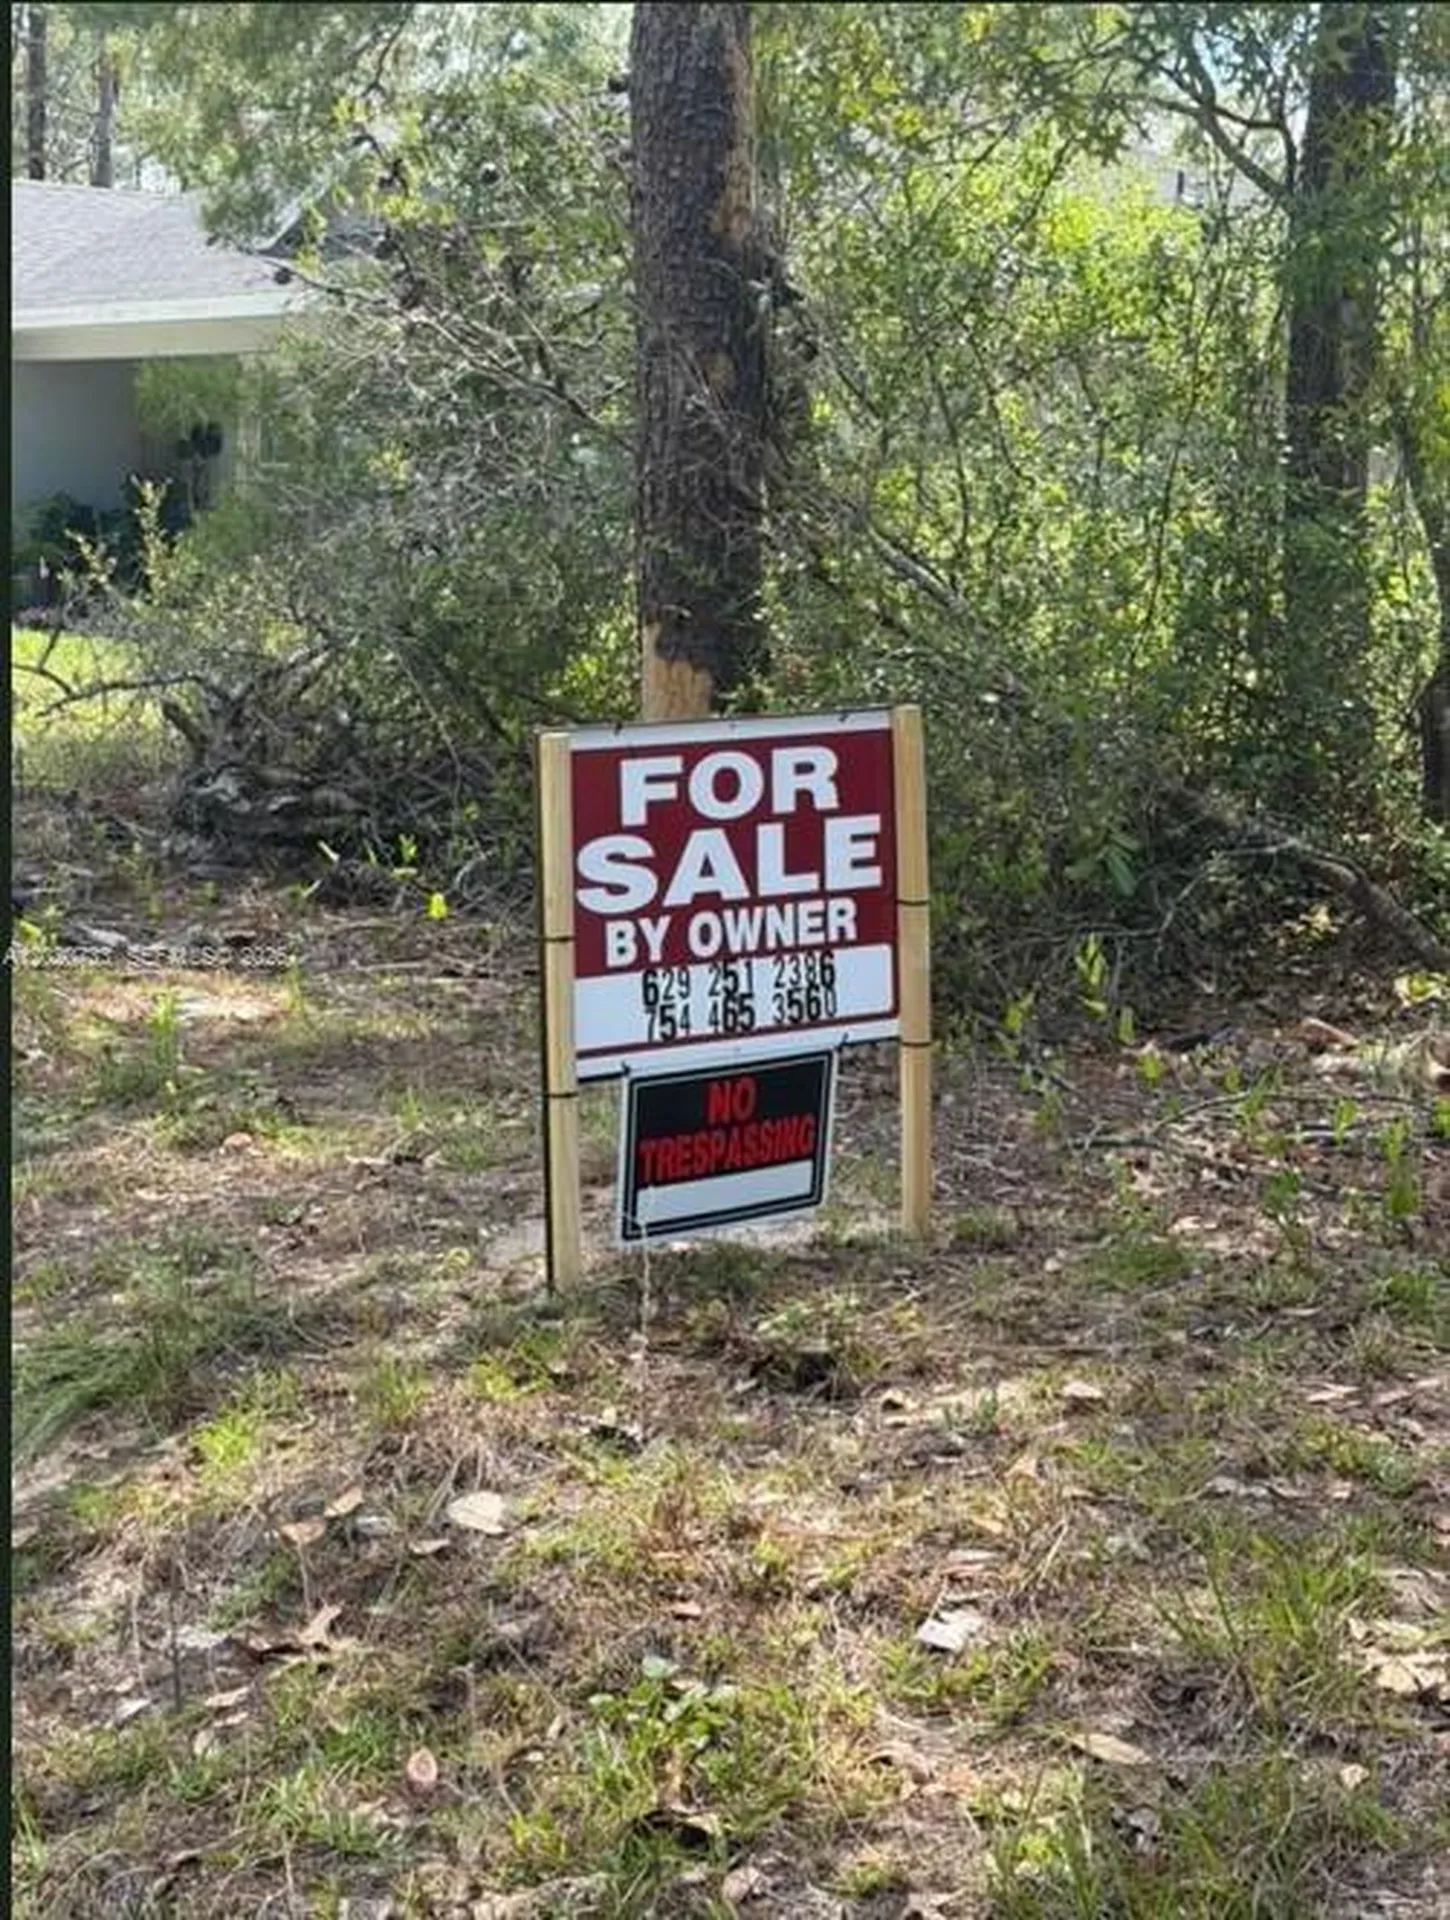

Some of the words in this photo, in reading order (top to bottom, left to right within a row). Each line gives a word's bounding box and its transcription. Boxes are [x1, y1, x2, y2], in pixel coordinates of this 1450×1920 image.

[620, 745, 840, 827] FOR
[576, 815, 882, 914] SALE
[606, 914, 671, 968] BY
[688, 899, 857, 958] OWNER
[642, 967, 691, 1006] 629
[708, 958, 754, 996] 251
[773, 950, 835, 988] 2386
[645, 1003, 691, 1042] 754
[708, 993, 755, 1034] 465
[773, 983, 837, 1024] 3560
[707, 1076, 757, 1126] NO
[638, 1119, 815, 1184] TRESPASSING
